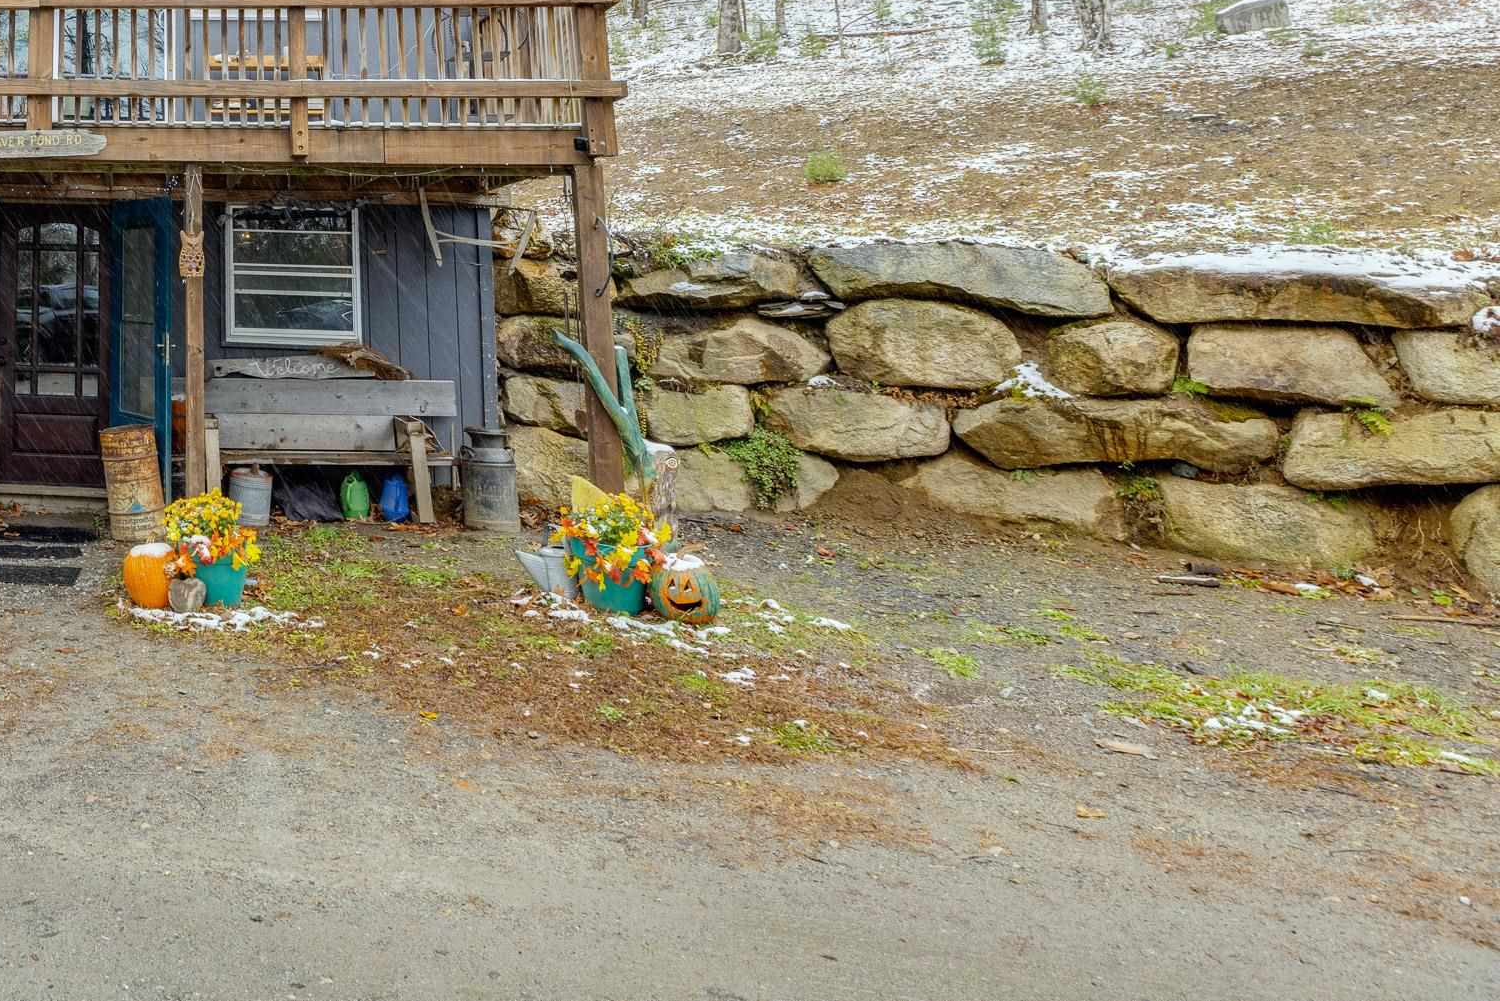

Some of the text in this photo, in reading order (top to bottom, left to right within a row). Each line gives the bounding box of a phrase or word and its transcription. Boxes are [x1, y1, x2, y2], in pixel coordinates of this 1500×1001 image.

[30, 134, 60, 146] POND
[66, 133, 82, 145] RD
[248, 358, 340, 377] Welcome
